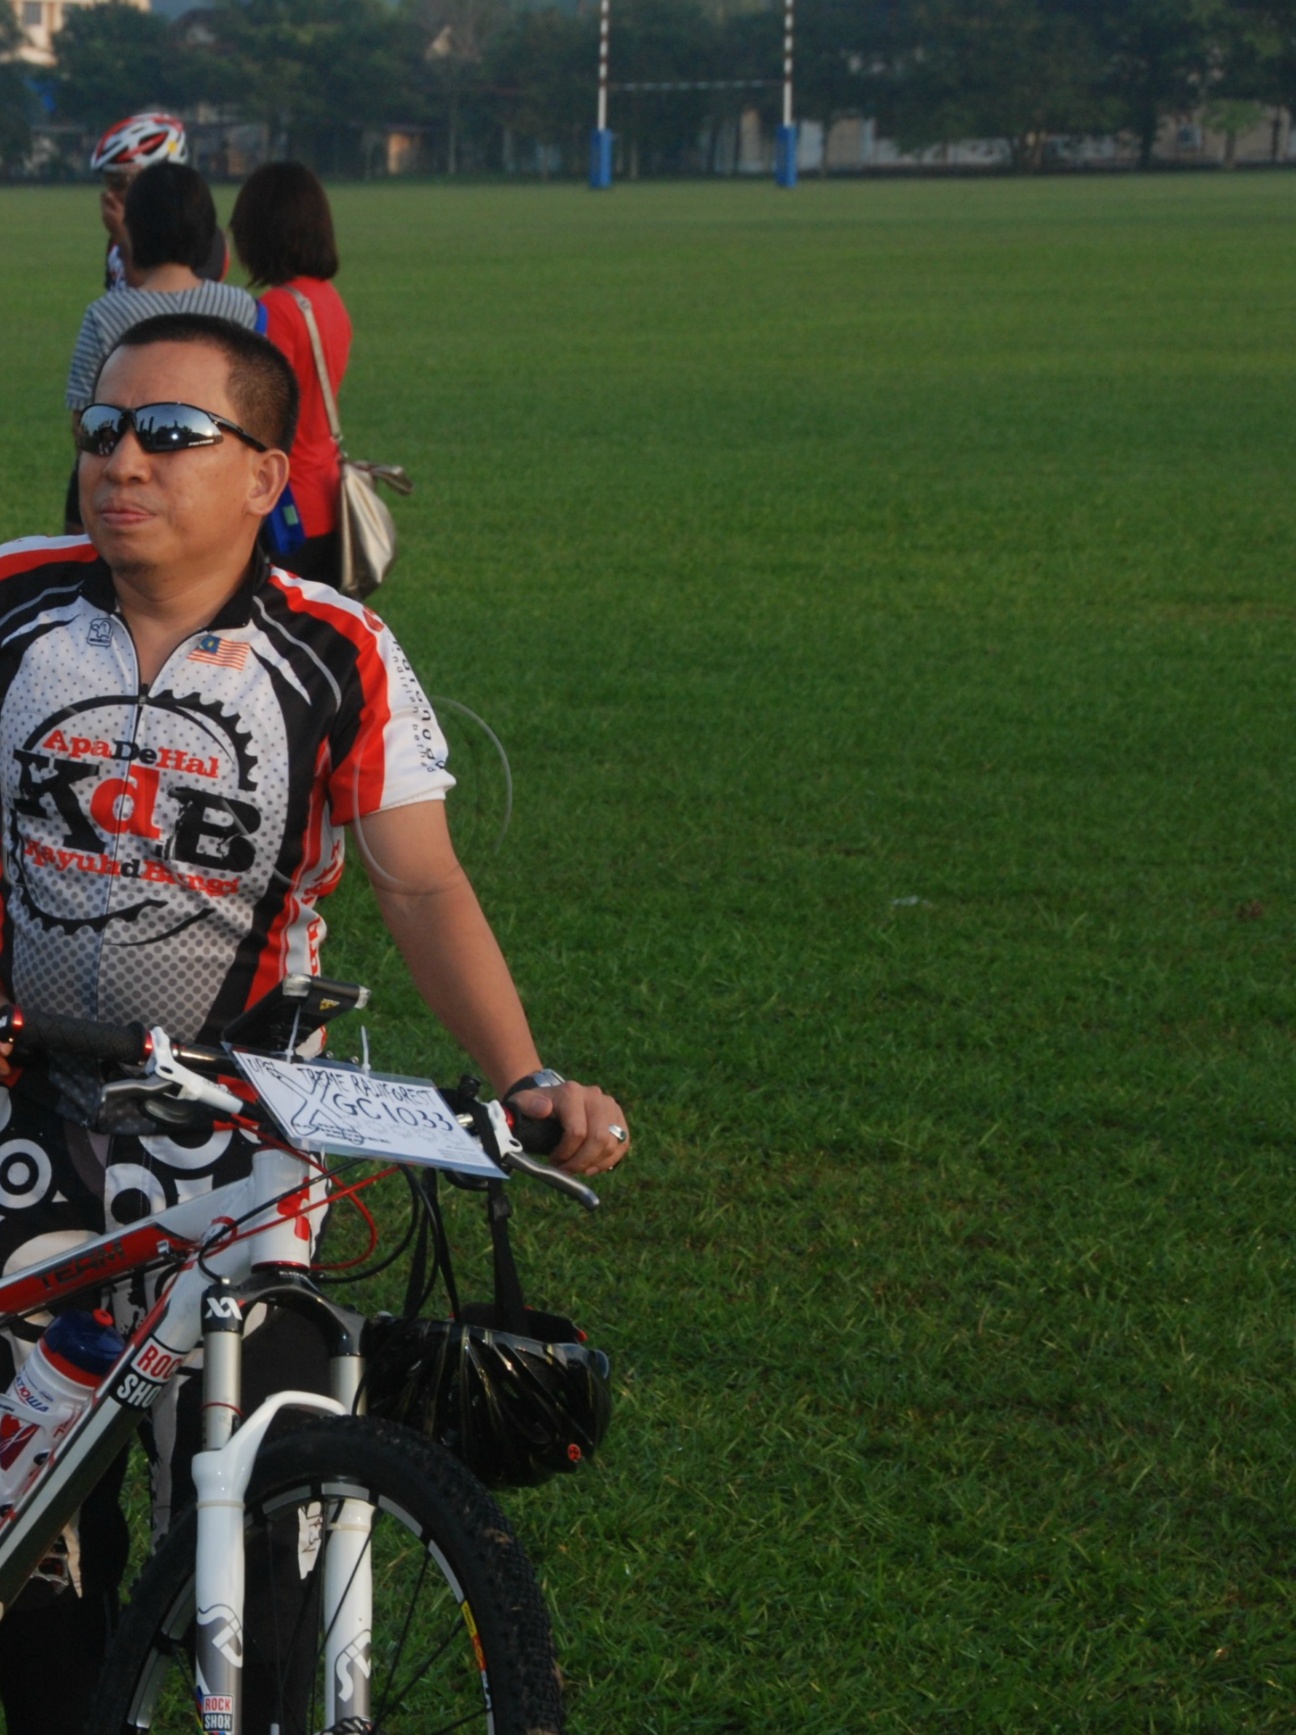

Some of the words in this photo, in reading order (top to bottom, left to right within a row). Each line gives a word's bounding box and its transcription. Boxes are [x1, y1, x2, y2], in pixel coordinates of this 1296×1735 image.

[42, 729, 219, 779] ApaDeHal
[12, 748, 262, 873] KdB
[353, 1073, 435, 1107] RAINFOREST
[37, 1240, 126, 1291] TEAM
[135, 1345, 181, 1380] ROC
[116, 1373, 160, 1409] SHO
[205, 1698, 231, 1712] ROCK
[205, 1714, 232, 1730] SHOX
